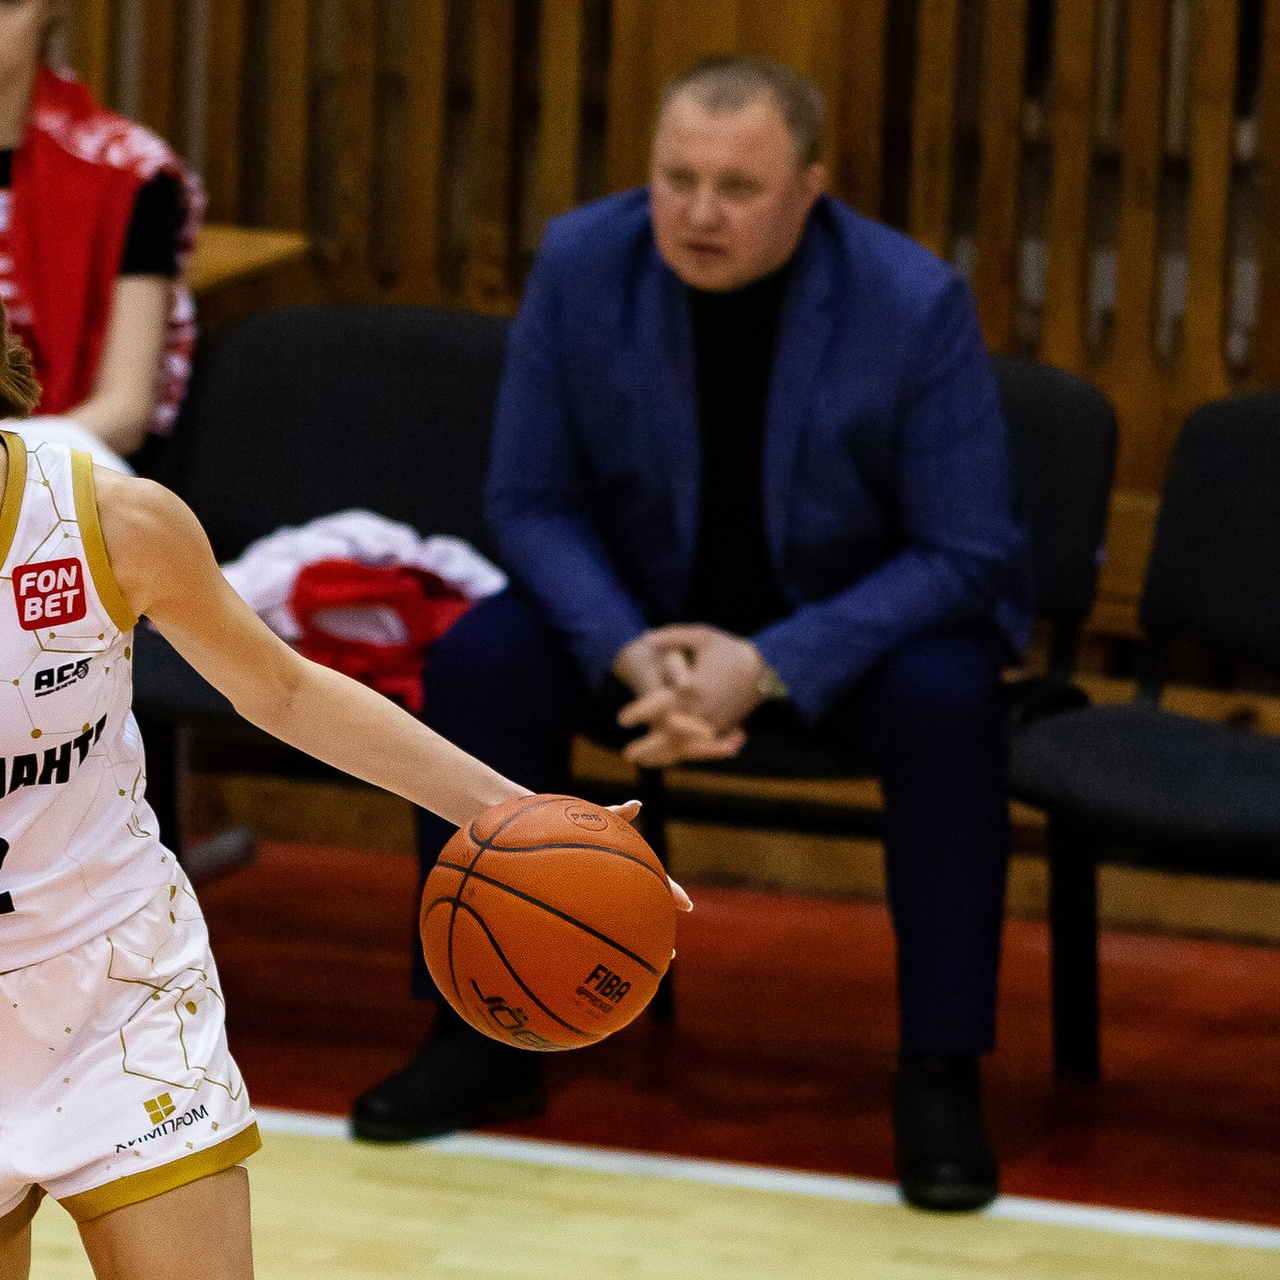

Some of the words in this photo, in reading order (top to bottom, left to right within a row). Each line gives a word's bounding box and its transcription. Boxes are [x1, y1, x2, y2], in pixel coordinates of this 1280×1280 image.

[19, 565, 78, 597] FON
[23, 588, 80, 622] BET
[584, 963, 631, 1004] FIBA
